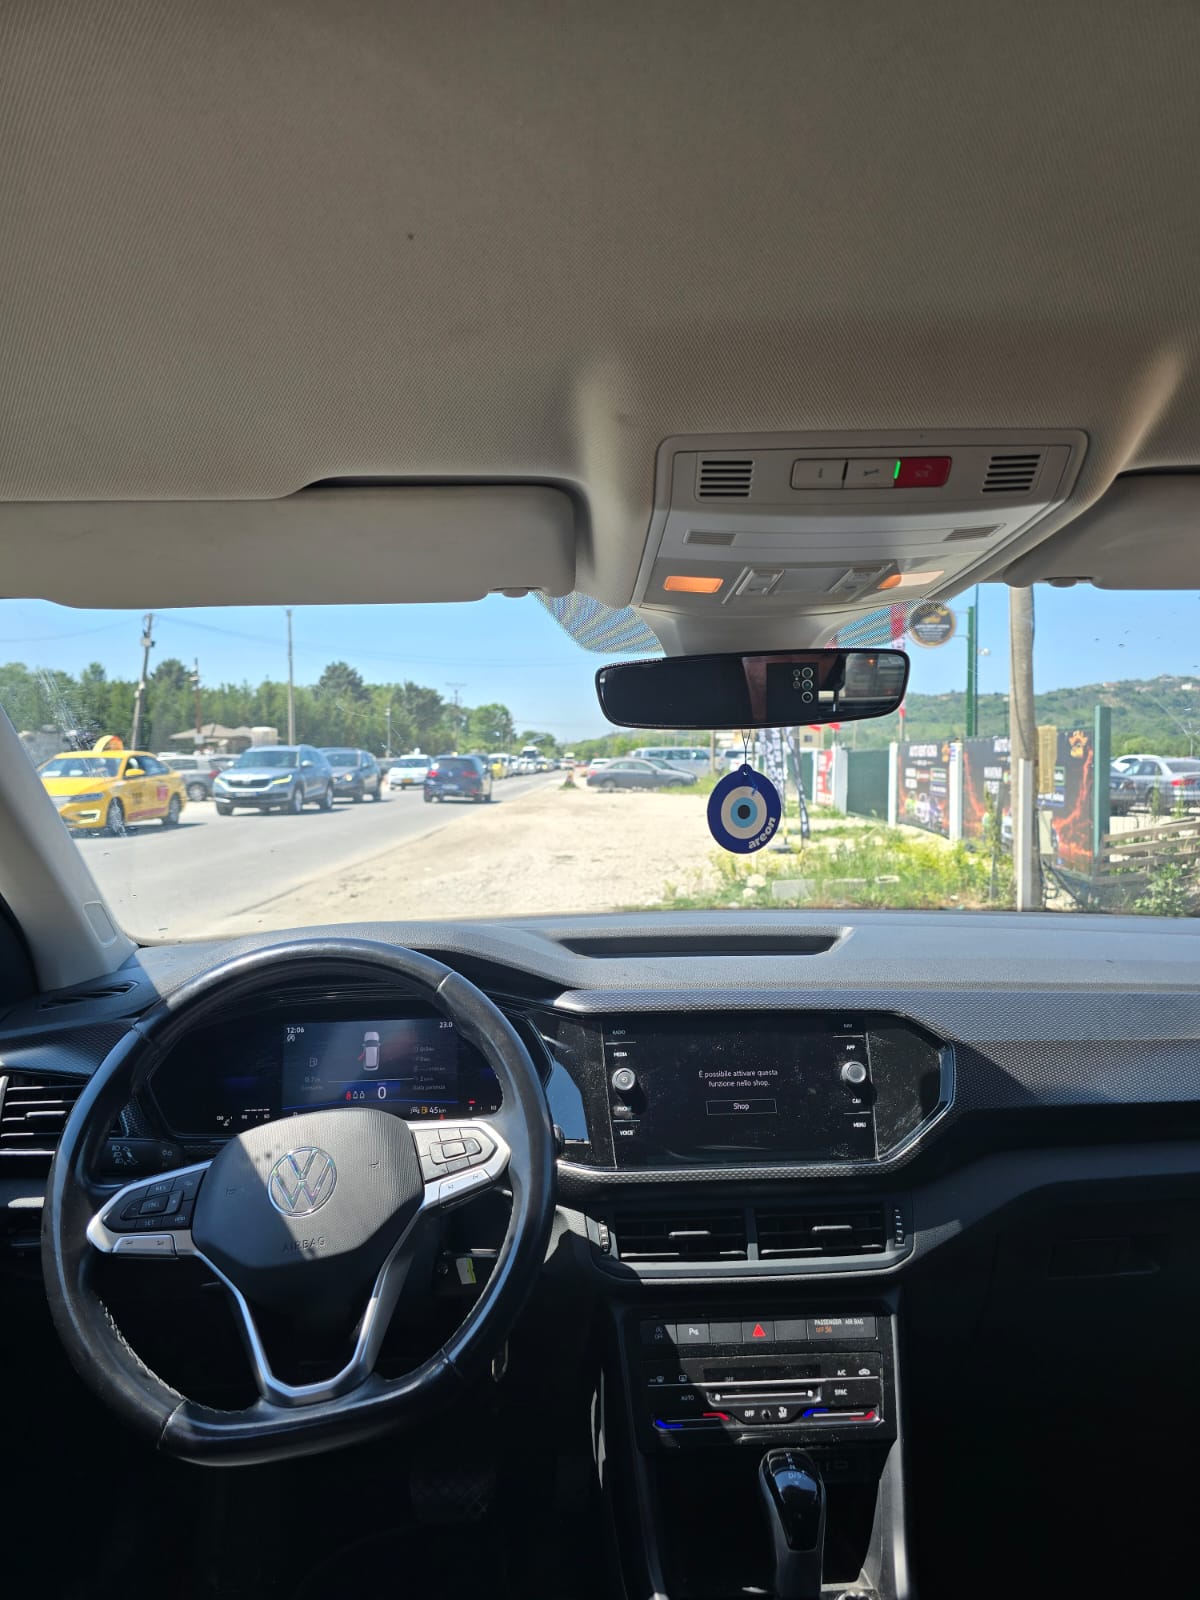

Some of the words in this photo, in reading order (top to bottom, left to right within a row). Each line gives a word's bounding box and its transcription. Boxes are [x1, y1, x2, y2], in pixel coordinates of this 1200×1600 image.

[747, 816, 776, 849] areon
[439, 1021, 453, 1029] 23.0
[286, 1026, 305, 1034] 12:06
[704, 1070, 732, 1079] possibile
[733, 1069, 756, 1077] attivare
[757, 1068, 778, 1077] questa
[708, 1080, 735, 1088] funzione
[753, 1079, 771, 1087] shop.
[377, 1086, 387, 1100] 0
[733, 1102, 750, 1111] Shop
[282, 1236, 326, 1254] AIRBAG
[744, 1408, 755, 1417] OFF
